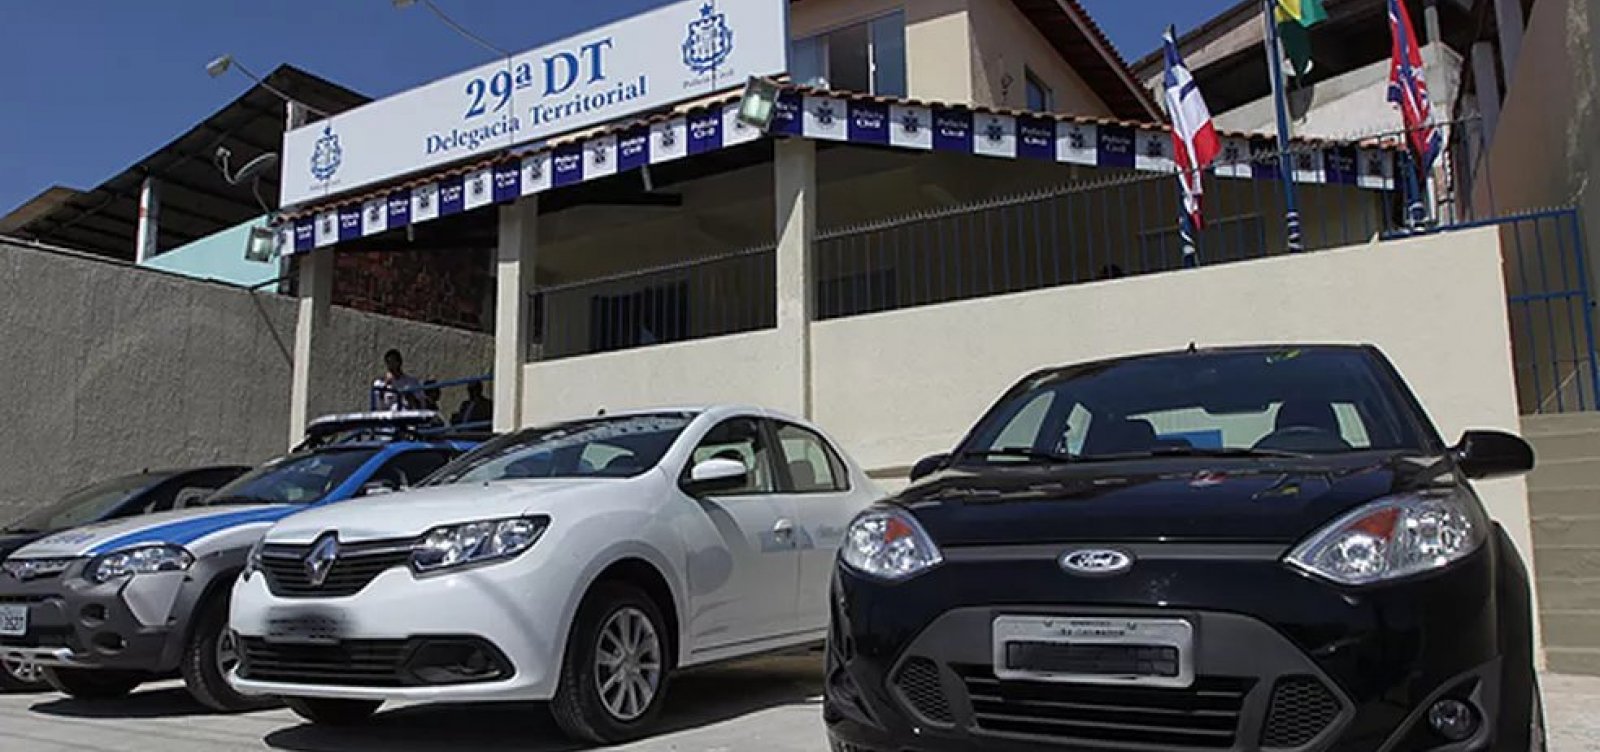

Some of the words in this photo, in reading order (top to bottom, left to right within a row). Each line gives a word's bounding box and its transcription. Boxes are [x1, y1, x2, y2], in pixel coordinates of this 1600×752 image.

[542, 37, 613, 97] DT
[426, 115, 520, 155] Delegacia
[529, 75, 648, 125] Territorial
[1078, 552, 1112, 568] Ford
